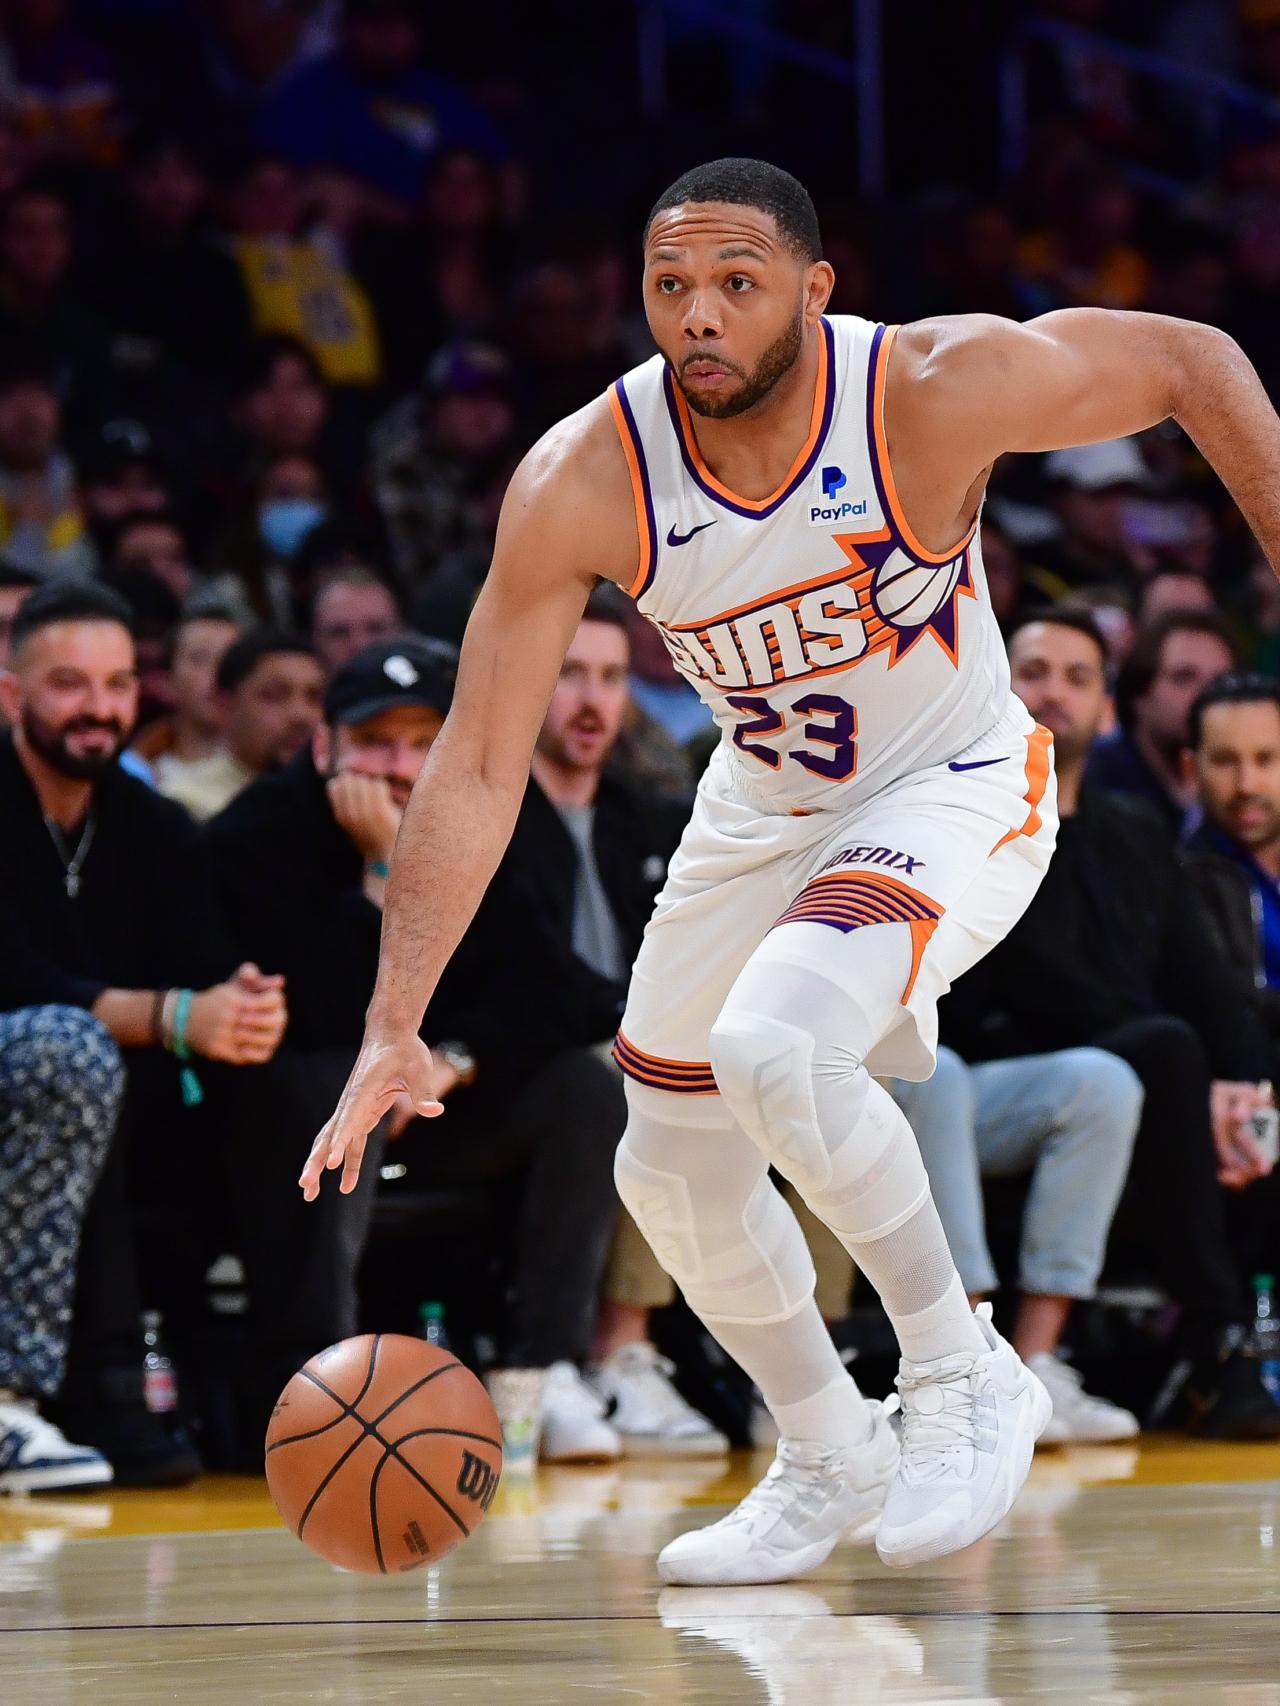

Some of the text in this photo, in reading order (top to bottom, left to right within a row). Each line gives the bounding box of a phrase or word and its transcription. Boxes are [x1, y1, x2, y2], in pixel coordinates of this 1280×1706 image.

[810, 500, 867, 521] PayPal
[724, 693, 859, 784] 23
[824, 846, 926, 877] OENIX
